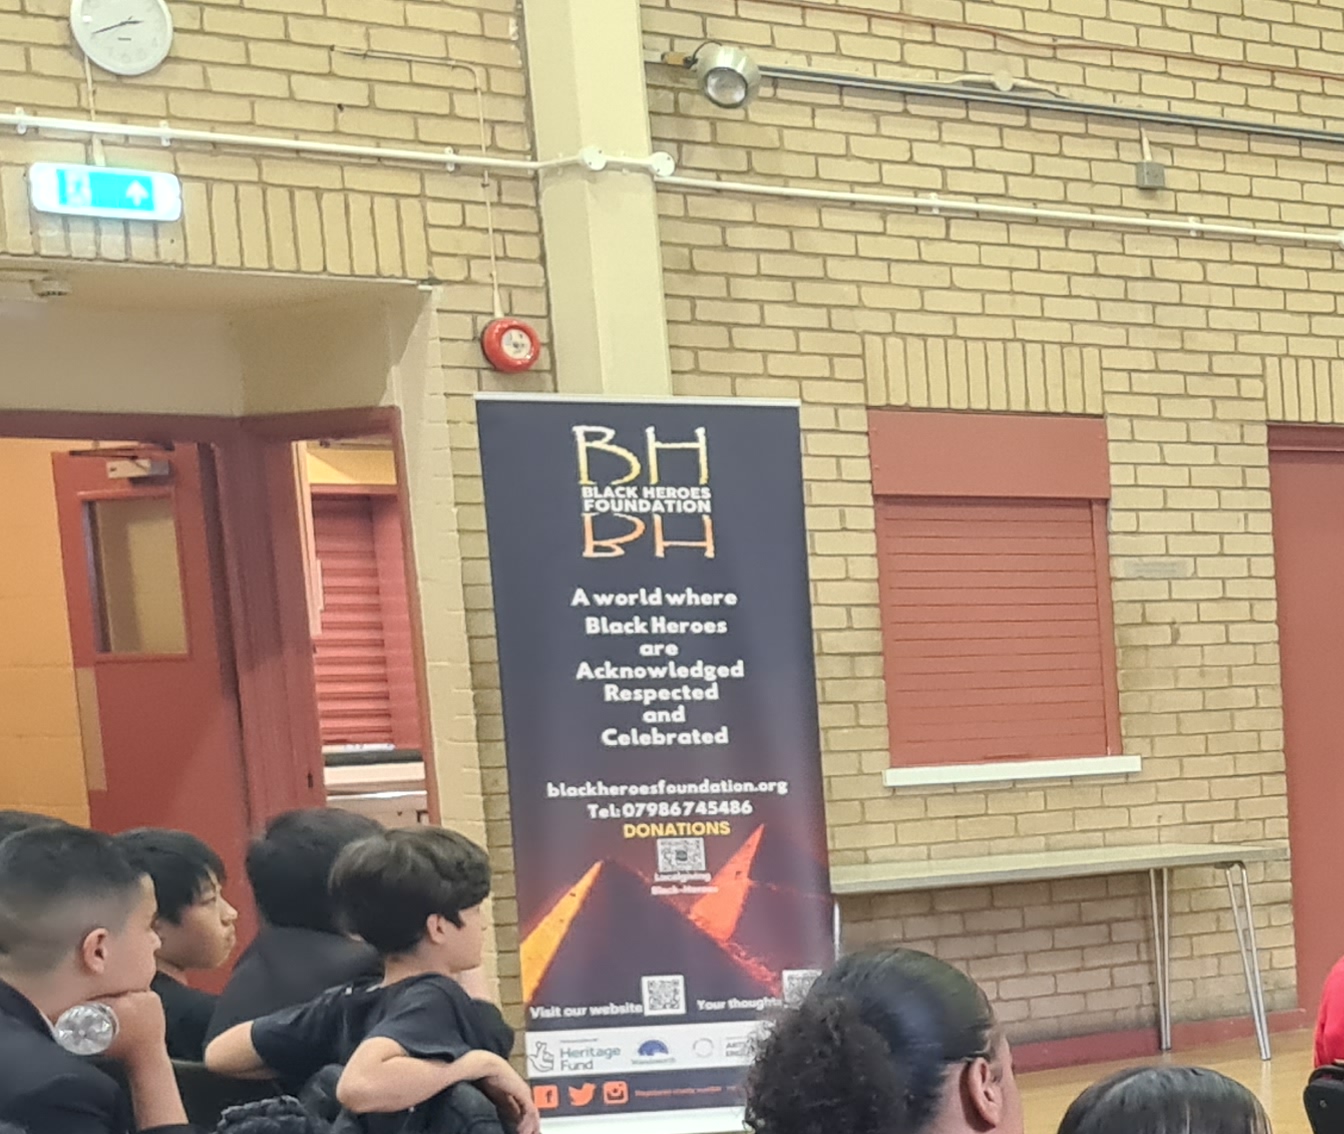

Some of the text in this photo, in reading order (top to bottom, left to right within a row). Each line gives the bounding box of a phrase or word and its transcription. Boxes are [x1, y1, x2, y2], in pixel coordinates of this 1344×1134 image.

[571, 425, 709, 485] BH
[581, 486, 712, 499] BLACK HEROES
[583, 499, 712, 513] FOUNDATION
[570, 587, 738, 606] A world where
[585, 616, 728, 634] Black Heroes
[639, 643, 679, 656] are
[576, 659, 745, 681] Acknowledged
[604, 682, 720, 705] Respected
[642, 704, 686, 723] and
[601, 726, 729, 746] Celebrated
[547, 779, 788, 798] blackheroesfoundation.org
[587, 803, 621, 818] Tel:
[623, 821, 731, 838] DONATIONS
[530, 1002, 643, 1019] Visit our website
[696, 999, 726, 1011] Your
[560, 1047, 621, 1059] Heritage
[560, 1060, 593, 1071] Fund
